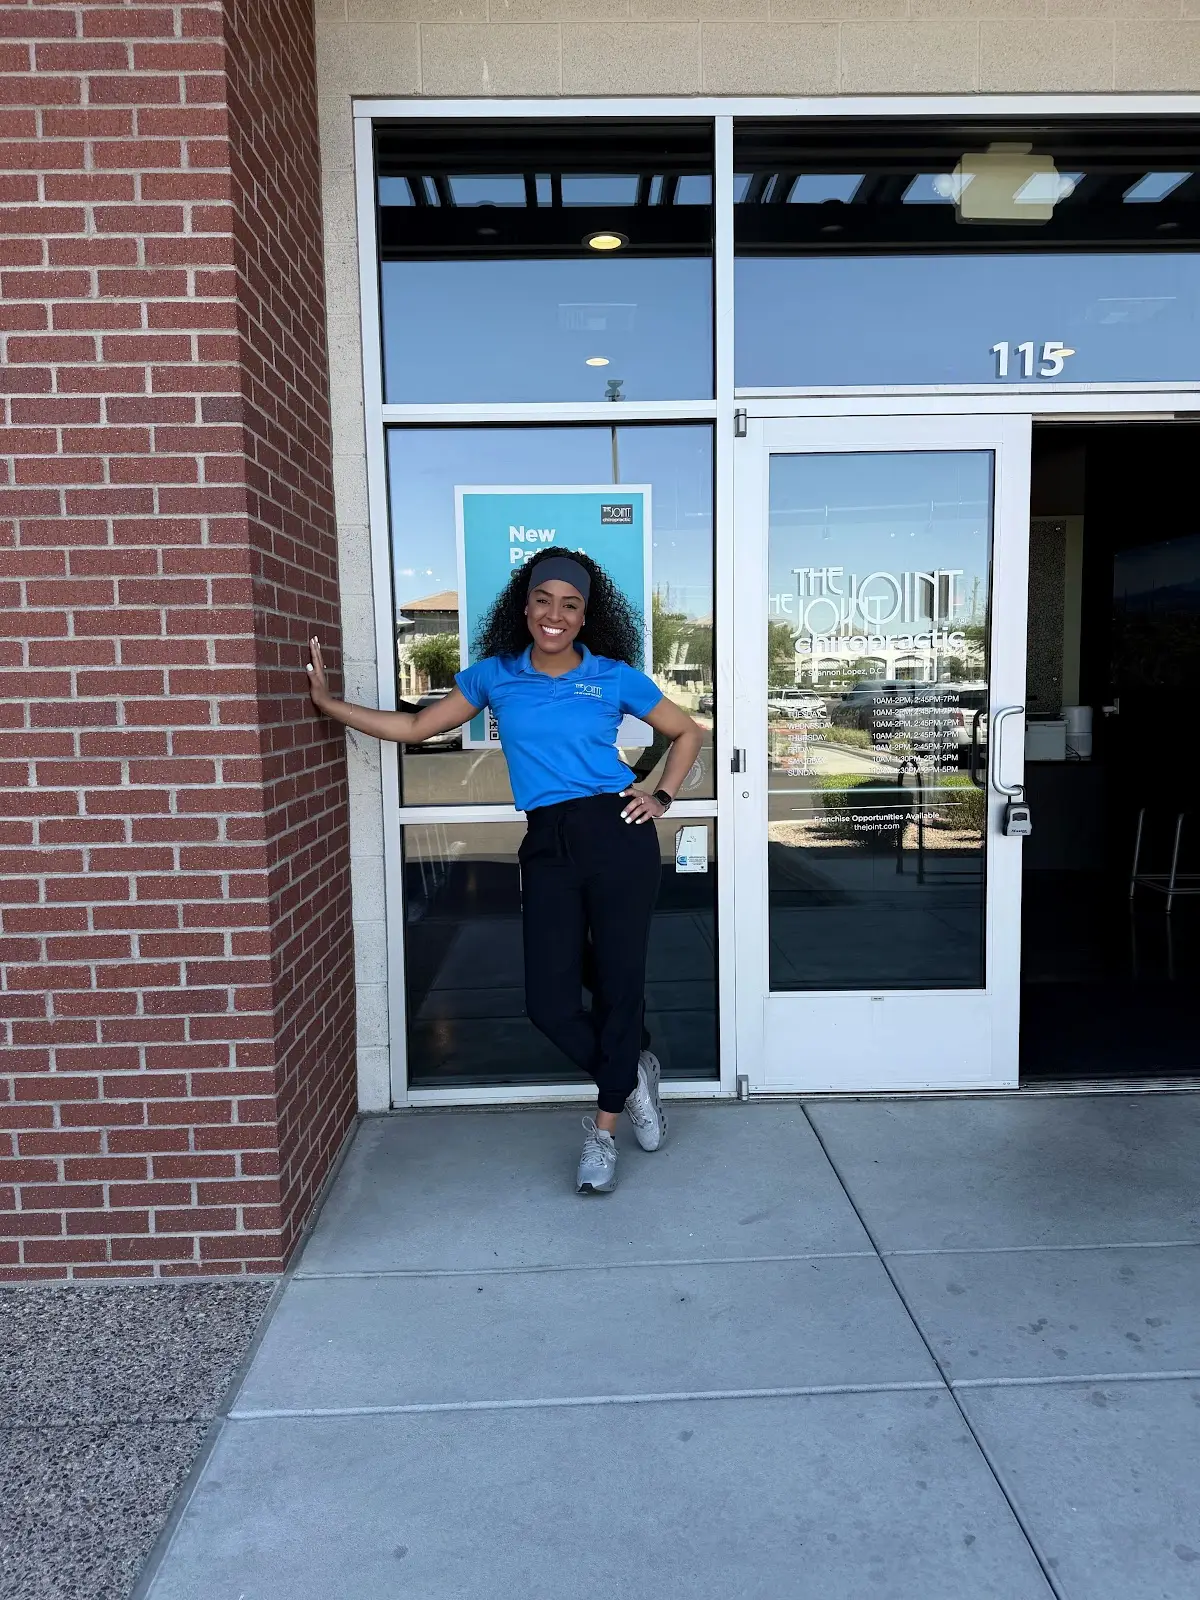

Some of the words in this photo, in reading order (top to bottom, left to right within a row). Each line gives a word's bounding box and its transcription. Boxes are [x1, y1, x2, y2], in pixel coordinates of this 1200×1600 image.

[993, 341, 1064, 377] 115
[509, 525, 556, 542] New
[793, 566, 844, 596] THE
[839, 569, 964, 626] JOINT
[767, 593, 793, 614] HE
[795, 627, 966, 655] chiropractic
[795, 667, 807, 677] r.
[808, 668, 841, 677] Sannon
[842, 667, 868, 677] Lopez,
[869, 667, 885, 675] D.C.
[872, 696, 913, 704] 10AM-2PM,
[914, 695, 959, 703] 2:45PM-7PM
[788, 722, 834, 730] WEDNESDAY
[872, 720, 913, 728] 10AM-2PM,
[914, 719, 959, 727] 2:45PM-7PM
[872, 732, 913, 740] 10AM-2PM,
[914, 731, 959, 739] 2:45PM-7PM
[914, 743, 959, 751] 2:45PM-7PM
[814, 815, 850, 823] Franchise
[851, 812, 904, 823] Opportunities
[905, 811, 940, 820] Available
[854, 822, 900, 832] thejoint.com
